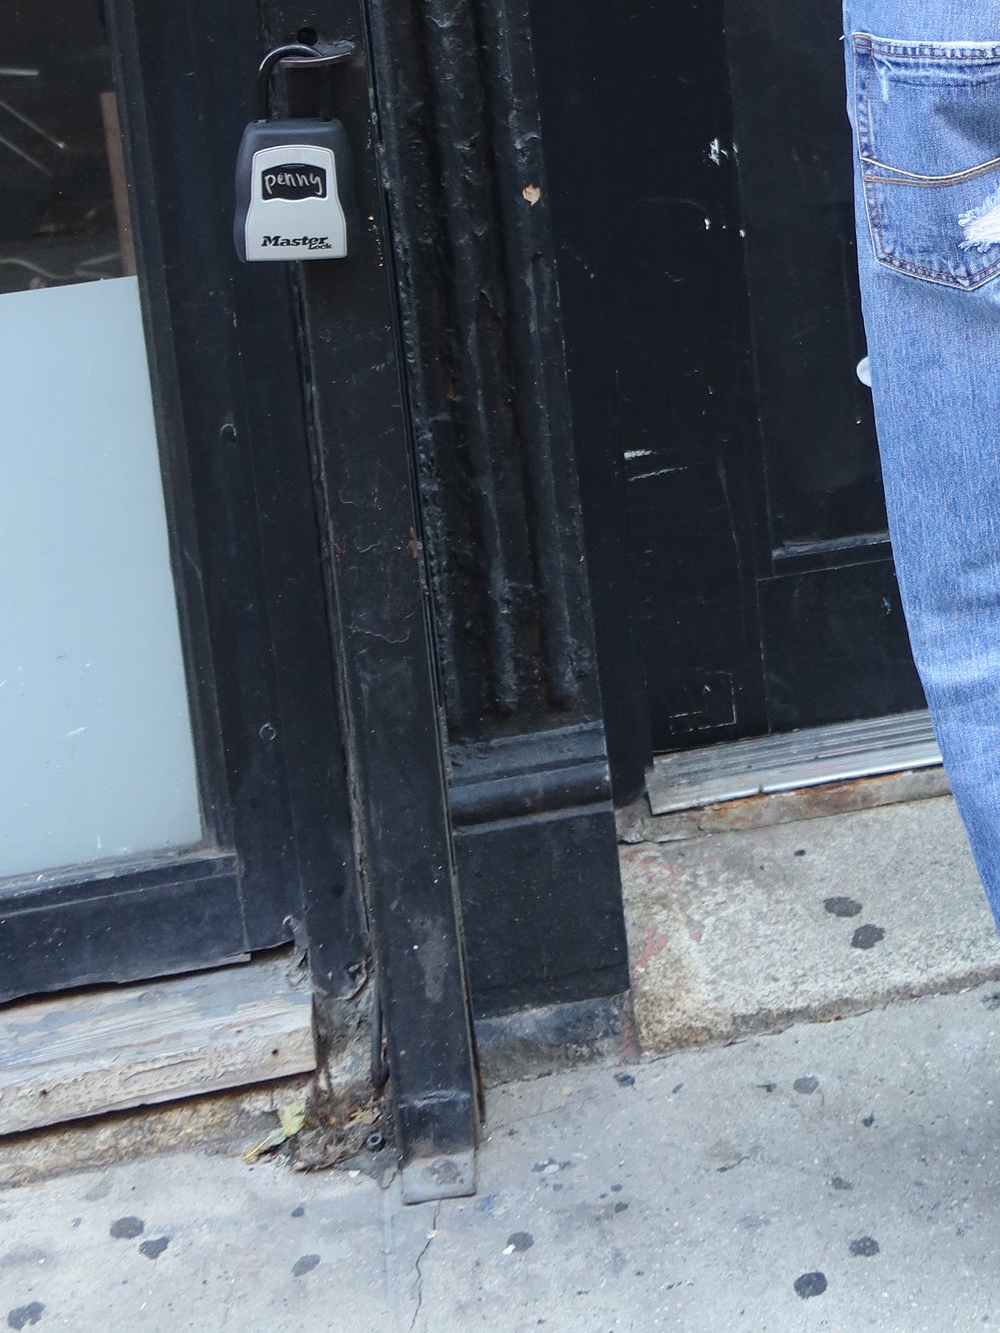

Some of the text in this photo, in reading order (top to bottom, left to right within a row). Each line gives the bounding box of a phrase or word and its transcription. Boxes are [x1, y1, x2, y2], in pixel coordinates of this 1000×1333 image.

[264, 171, 323, 196] penny
[261, 235, 328, 247] Master
[307, 242, 332, 250] Lock
